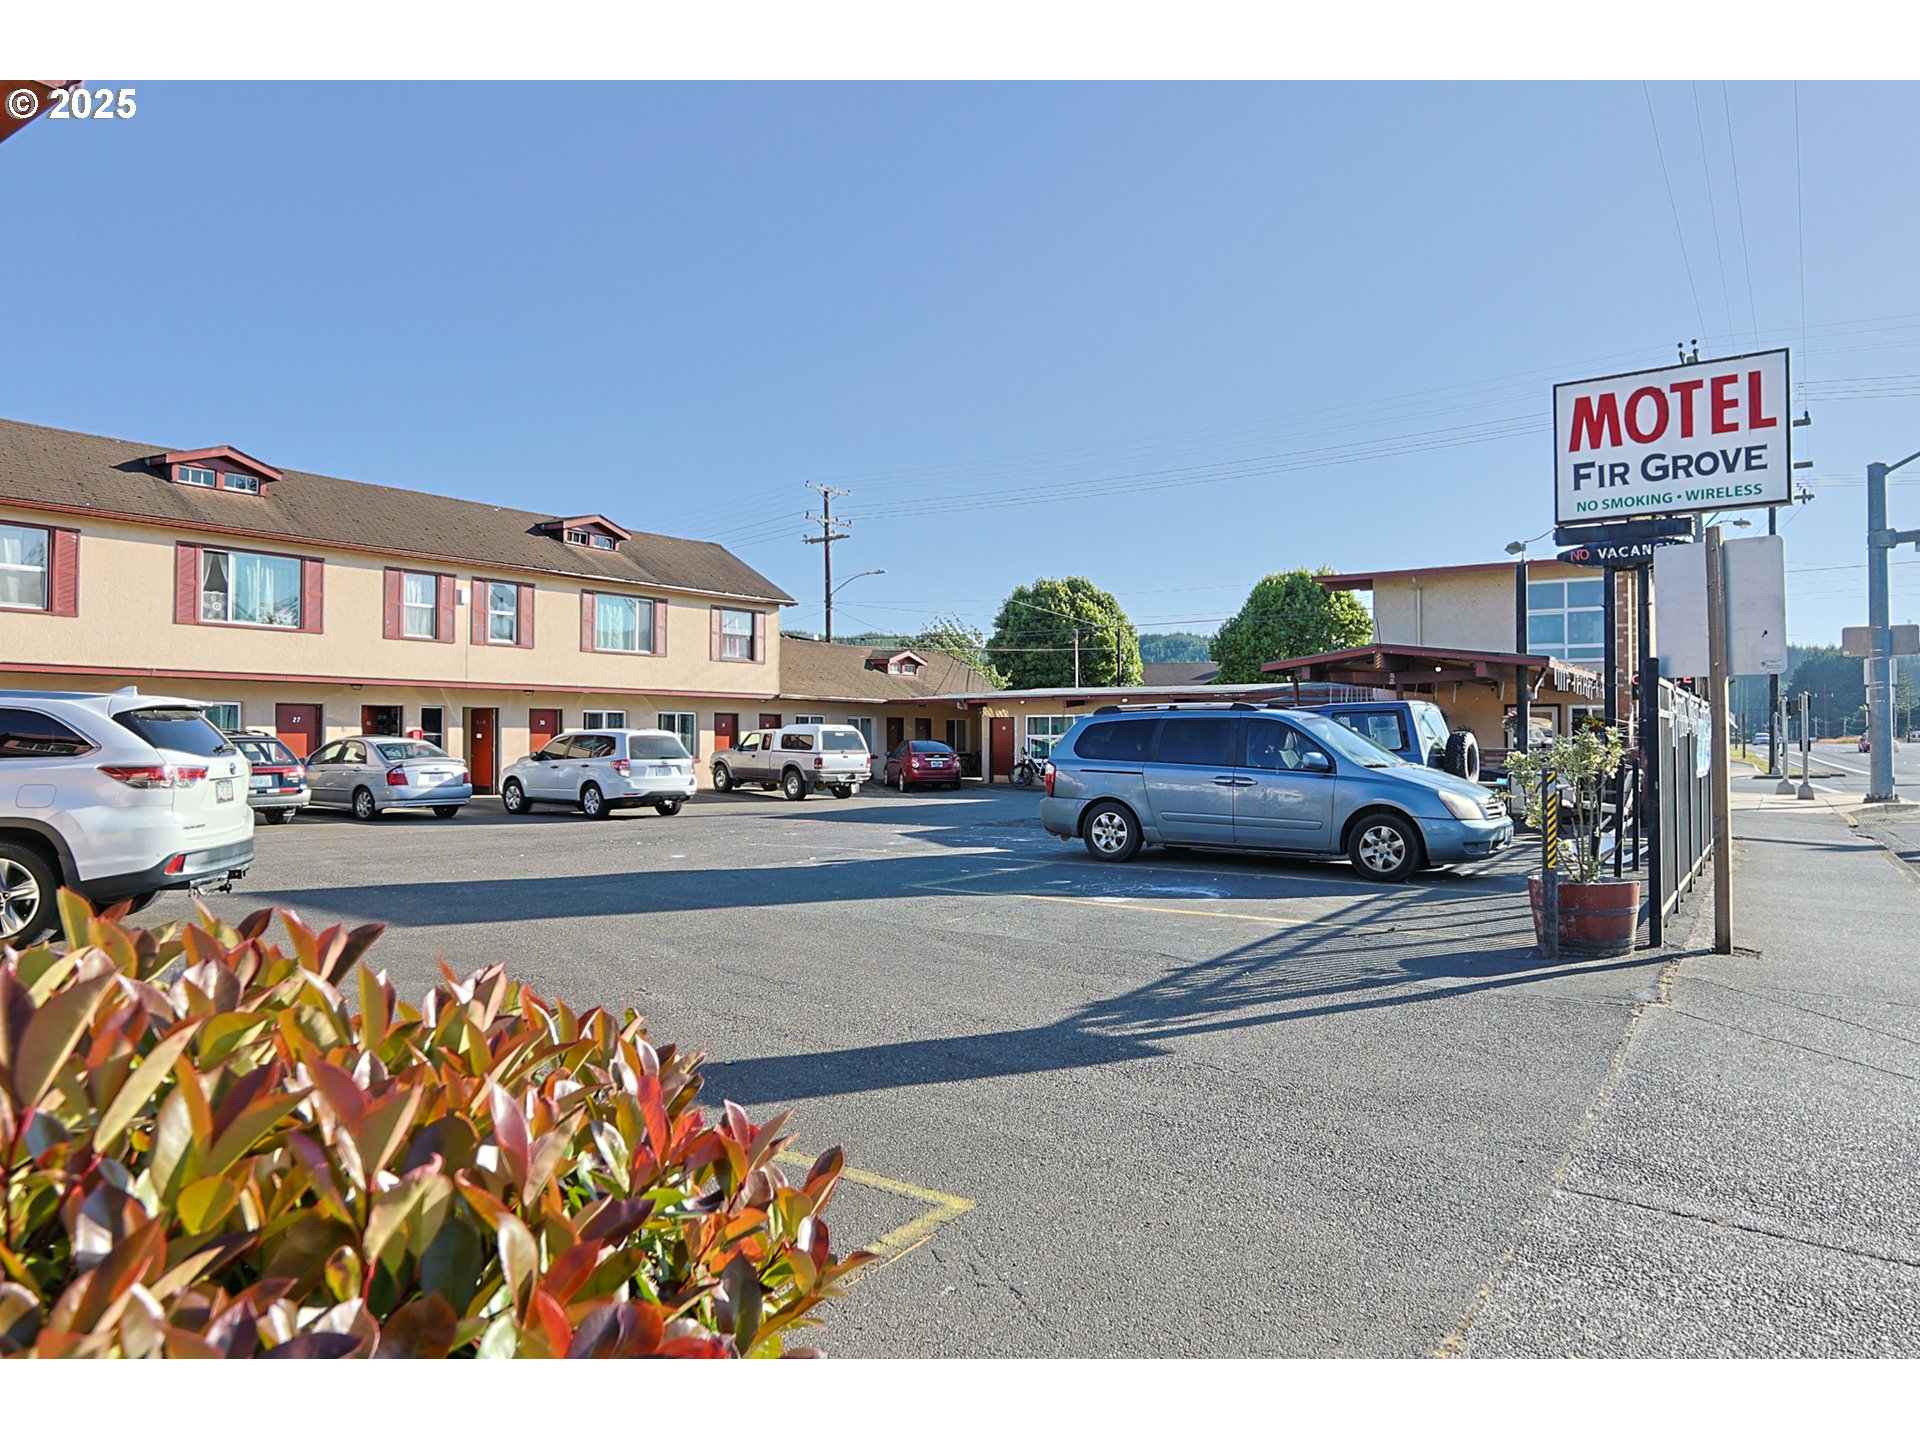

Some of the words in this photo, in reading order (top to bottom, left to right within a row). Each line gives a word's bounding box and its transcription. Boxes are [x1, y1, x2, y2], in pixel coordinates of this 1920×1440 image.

[1568, 370, 1777, 453] MOTEL
[1573, 460, 1630, 491] FIR
[1640, 444, 1768, 482] GROVE
[1576, 500, 1598, 513] NO
[1601, 492, 1673, 510] SMOKING
[1685, 483, 1763, 501] WIRELESS
[1570, 549, 1590, 561] NO
